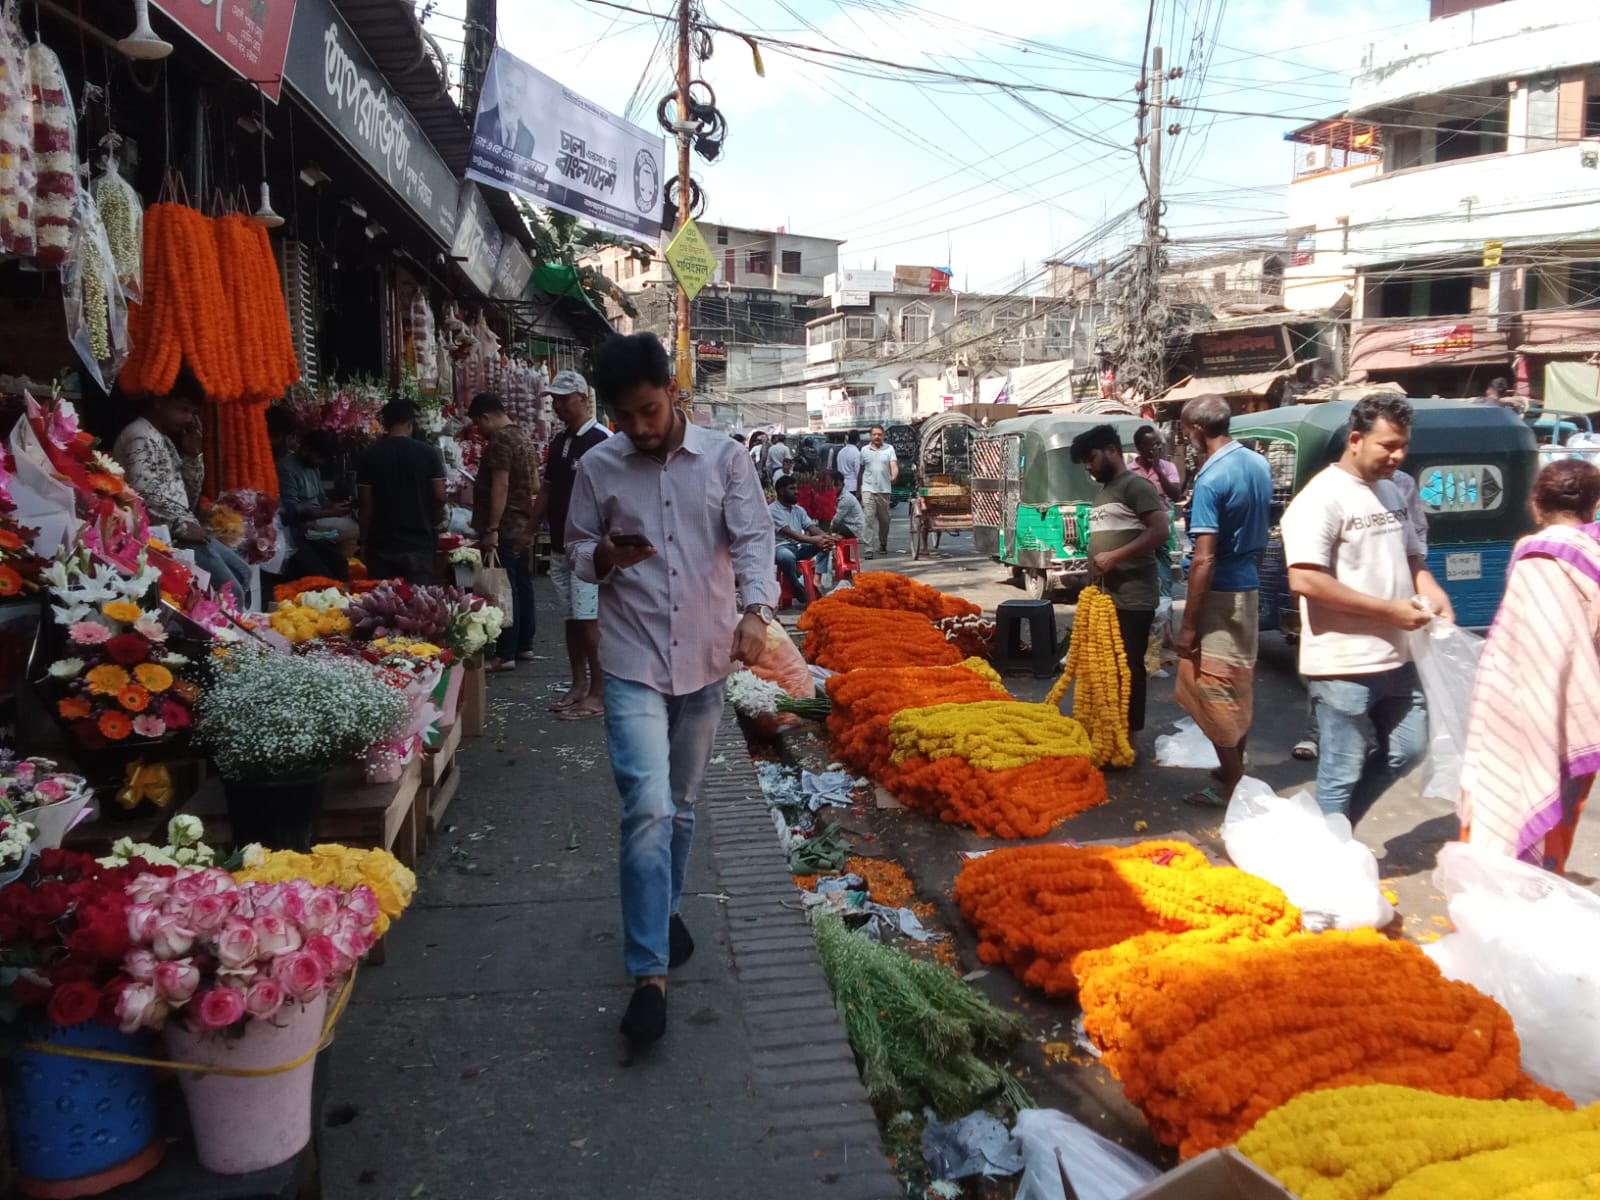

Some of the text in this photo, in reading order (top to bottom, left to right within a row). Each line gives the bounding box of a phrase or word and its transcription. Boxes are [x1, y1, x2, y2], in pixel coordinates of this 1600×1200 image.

[324, 22, 410, 184] অপরাজিতা
[560, 130, 586, 158] চলো
[555, 149, 616, 195] বাংলাদেশ
[676, 258, 709, 276] শপিংমল
